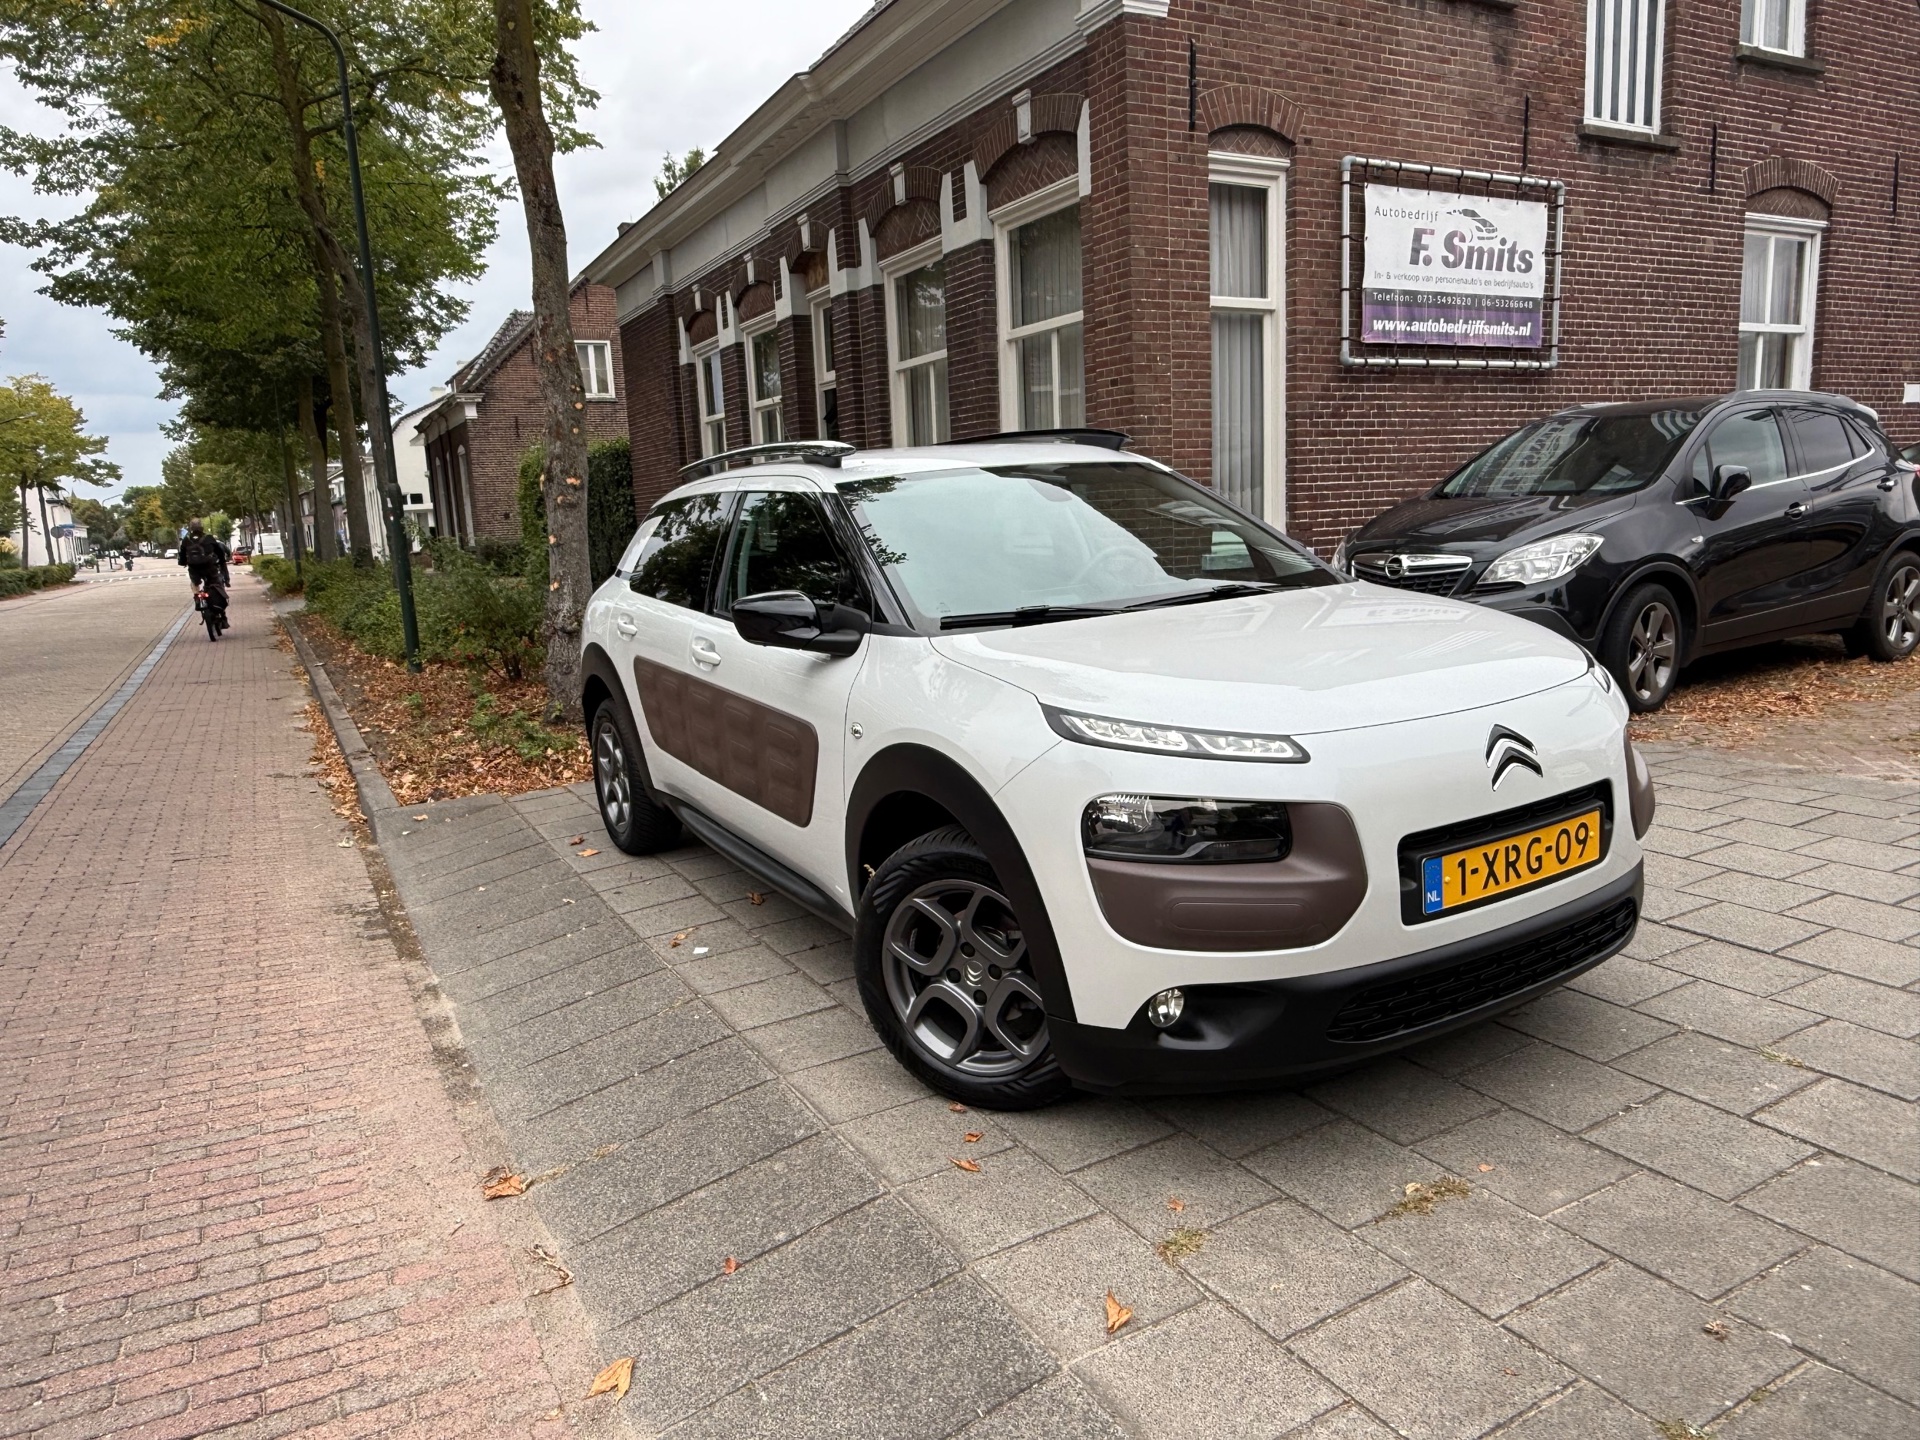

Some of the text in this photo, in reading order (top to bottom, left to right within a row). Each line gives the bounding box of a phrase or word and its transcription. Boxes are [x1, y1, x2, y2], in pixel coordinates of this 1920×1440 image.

[1374, 205, 1439, 223] Autobedrijf
[1409, 227, 1533, 274] F. Smits
[1393, 272, 1420, 283] verkoop
[1422, 274, 1434, 282] van
[1435, 276, 1483, 287] personenauto's
[1373, 291, 1414, 302] Telefoon:
[1417, 294, 1472, 306] 073-5492620
[1373, 317, 1532, 337] www.autobedrijffsmits.nl
[1456, 821, 1590, 896] 1-XRG-09
[1427, 889, 1441, 904] NL
